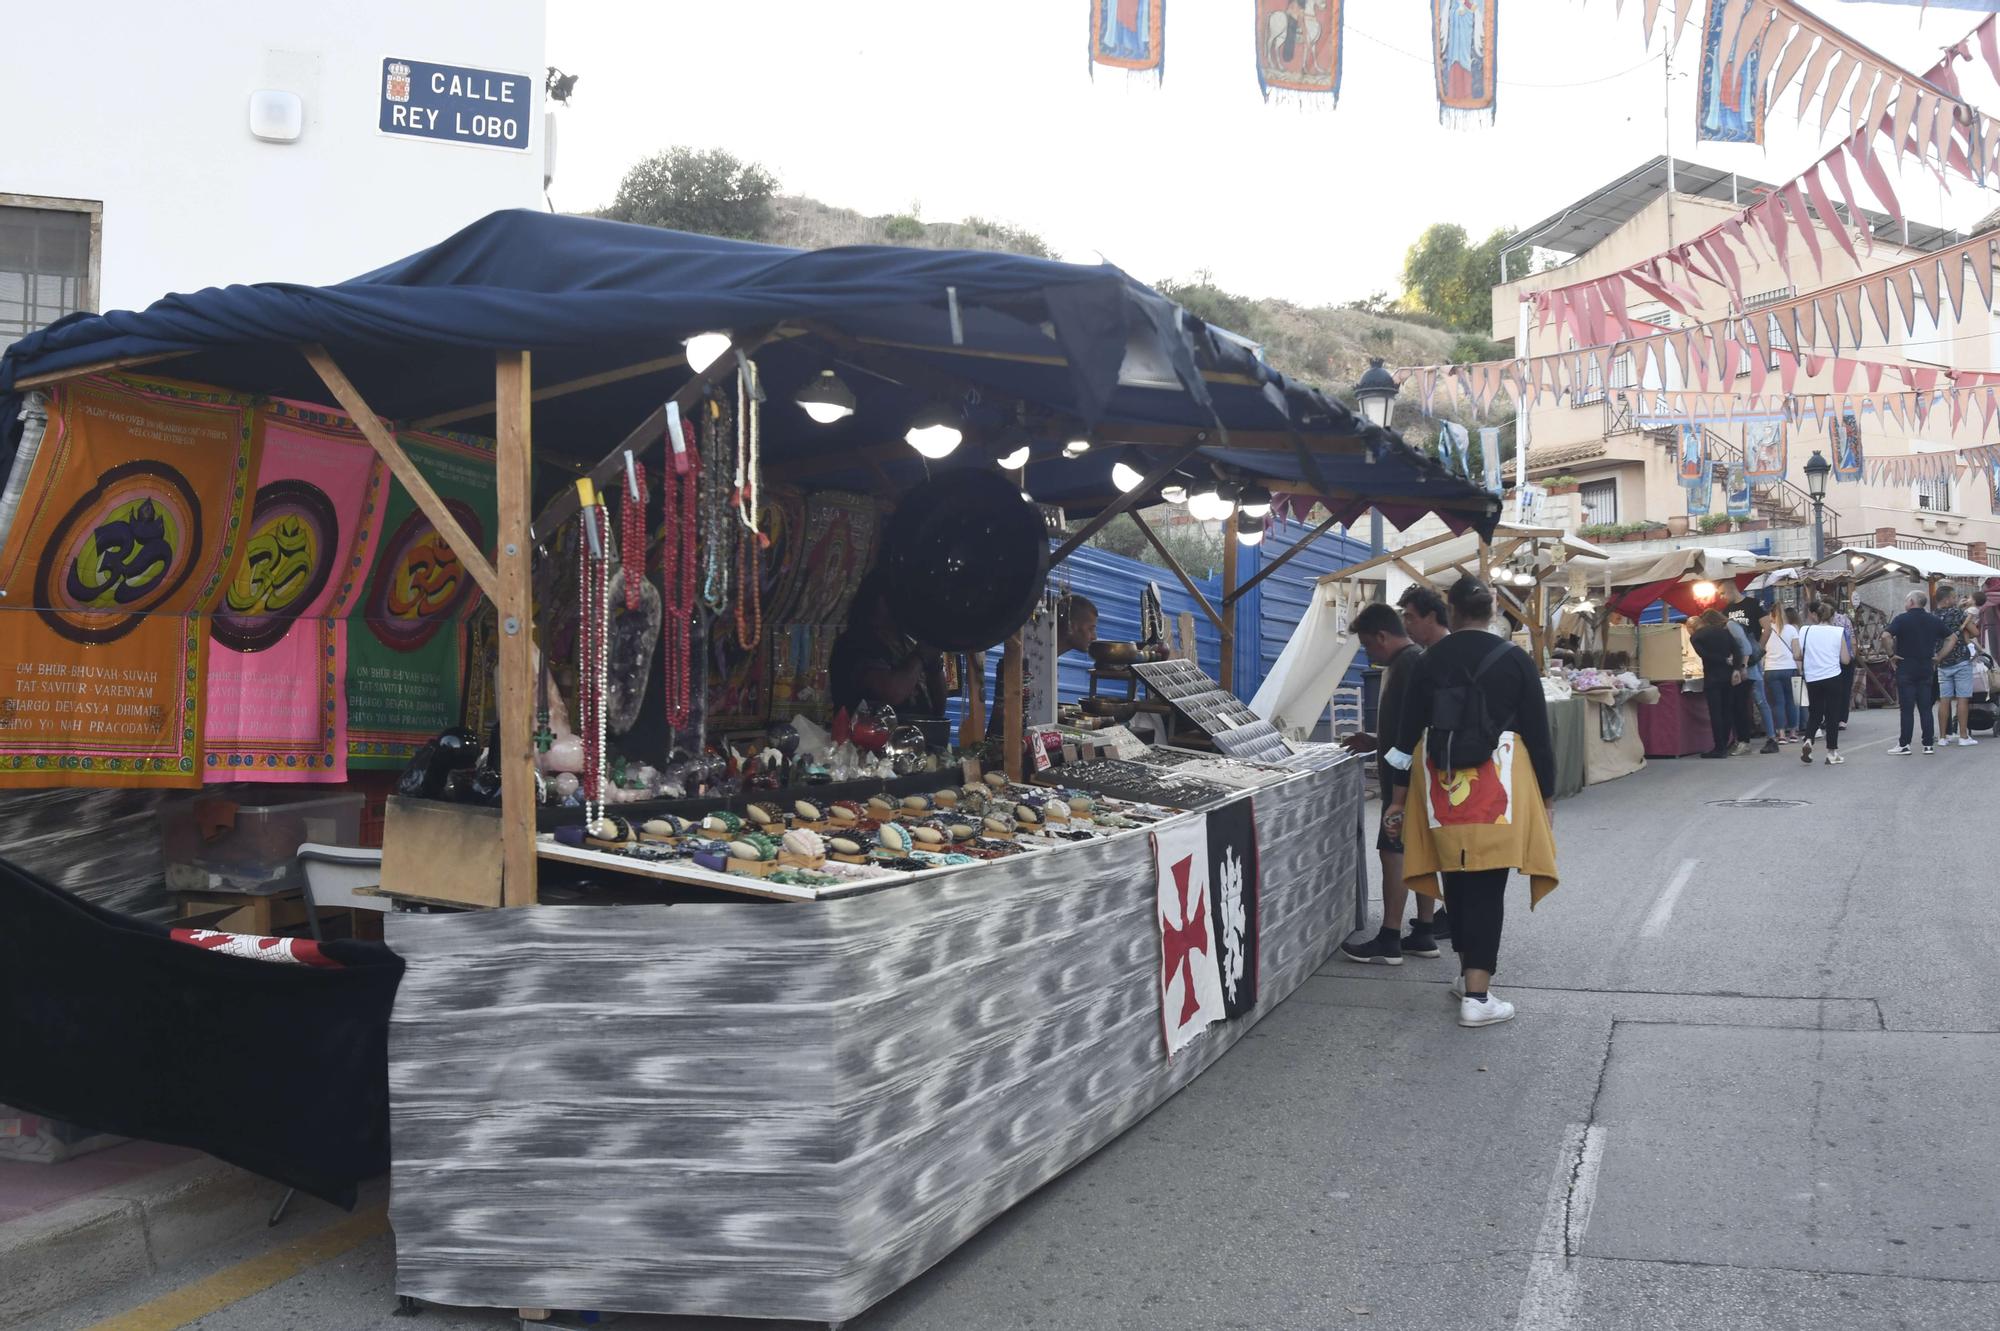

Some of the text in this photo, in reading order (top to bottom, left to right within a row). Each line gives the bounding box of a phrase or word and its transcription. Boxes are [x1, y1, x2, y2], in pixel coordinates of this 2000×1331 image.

[431, 72, 515, 103] CALLE
[392, 104, 517, 140] REY LOBO
